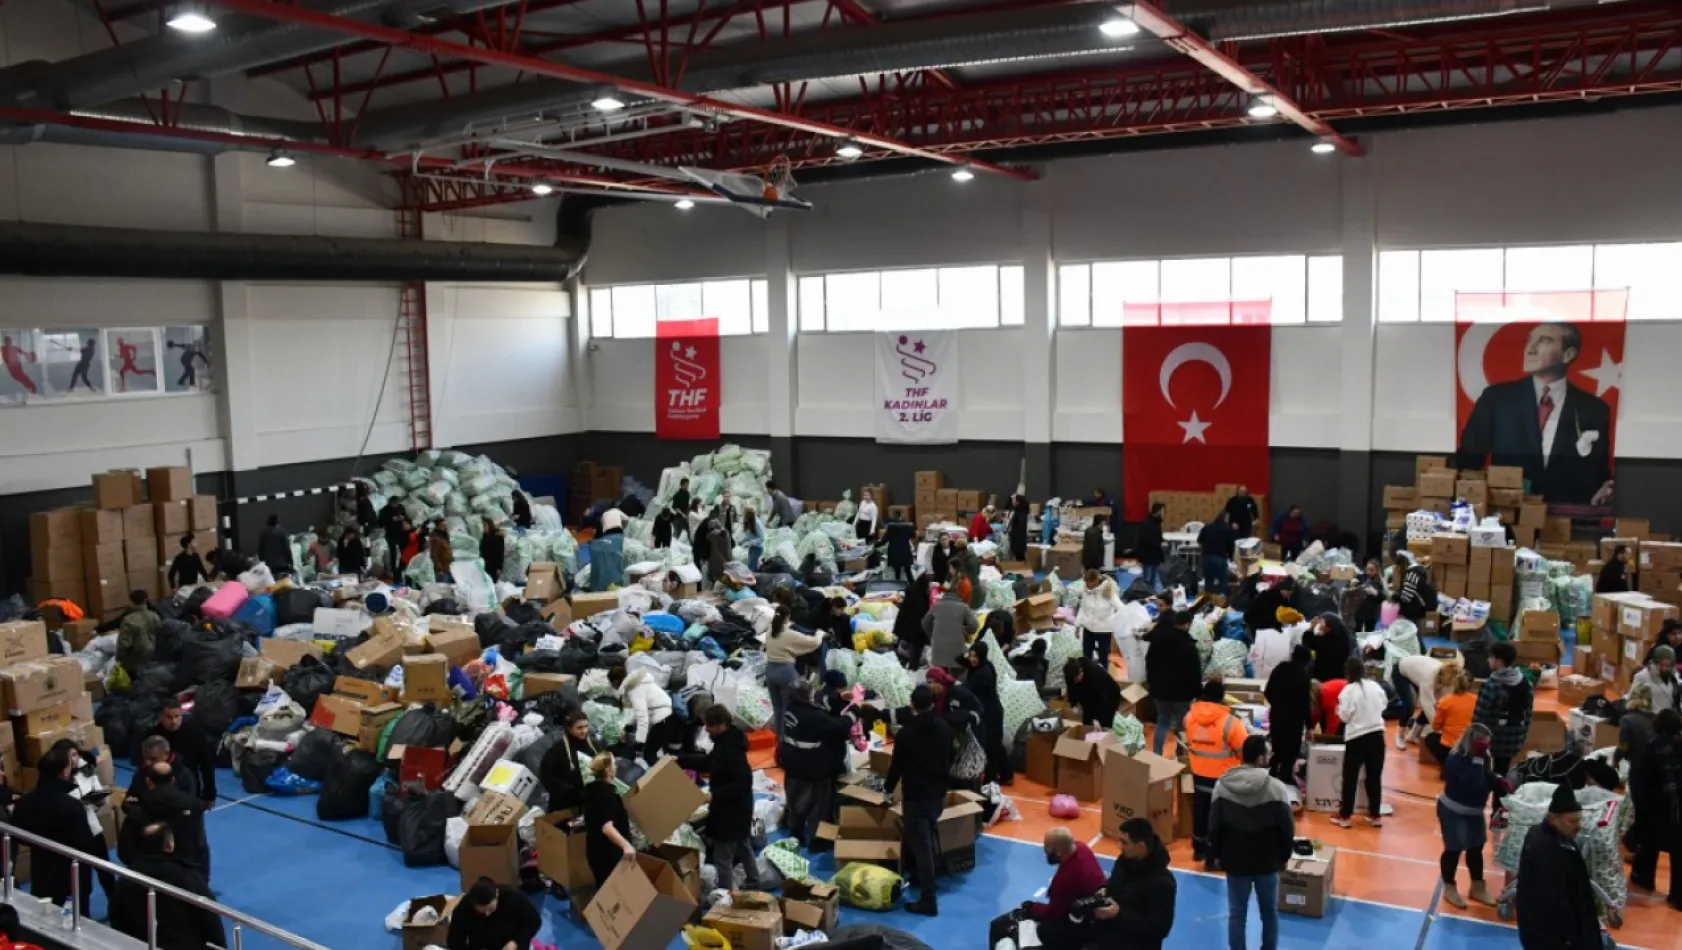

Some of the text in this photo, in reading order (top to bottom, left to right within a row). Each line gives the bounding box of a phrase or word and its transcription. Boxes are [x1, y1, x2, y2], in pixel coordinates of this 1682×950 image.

[668, 388, 707, 405] THF
[905, 387, 929, 397] THF
[883, 399, 947, 410] KADINLAR
[899, 412, 909, 422] 2.
